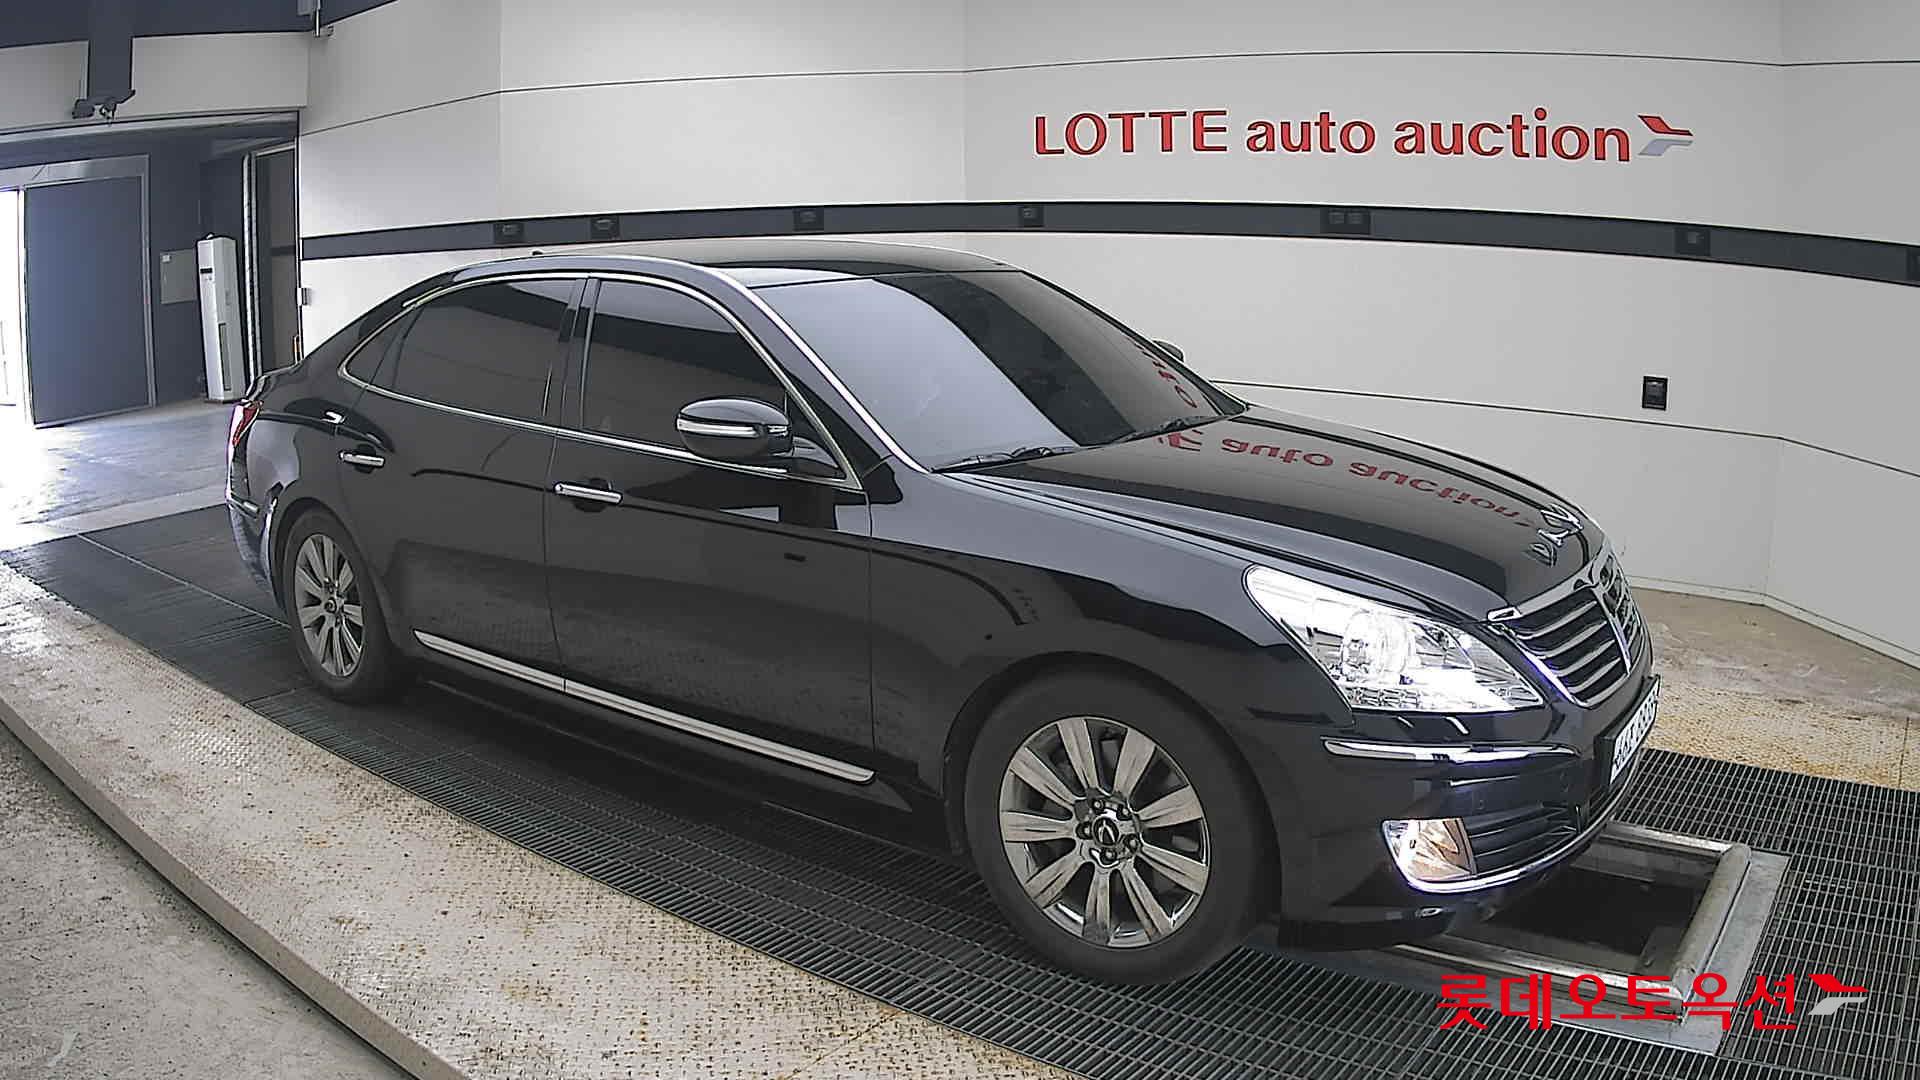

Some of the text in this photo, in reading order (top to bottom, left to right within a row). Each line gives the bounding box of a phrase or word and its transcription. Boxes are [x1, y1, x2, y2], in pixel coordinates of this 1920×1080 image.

[1035, 107, 1631, 162] LOTTE auto auction
